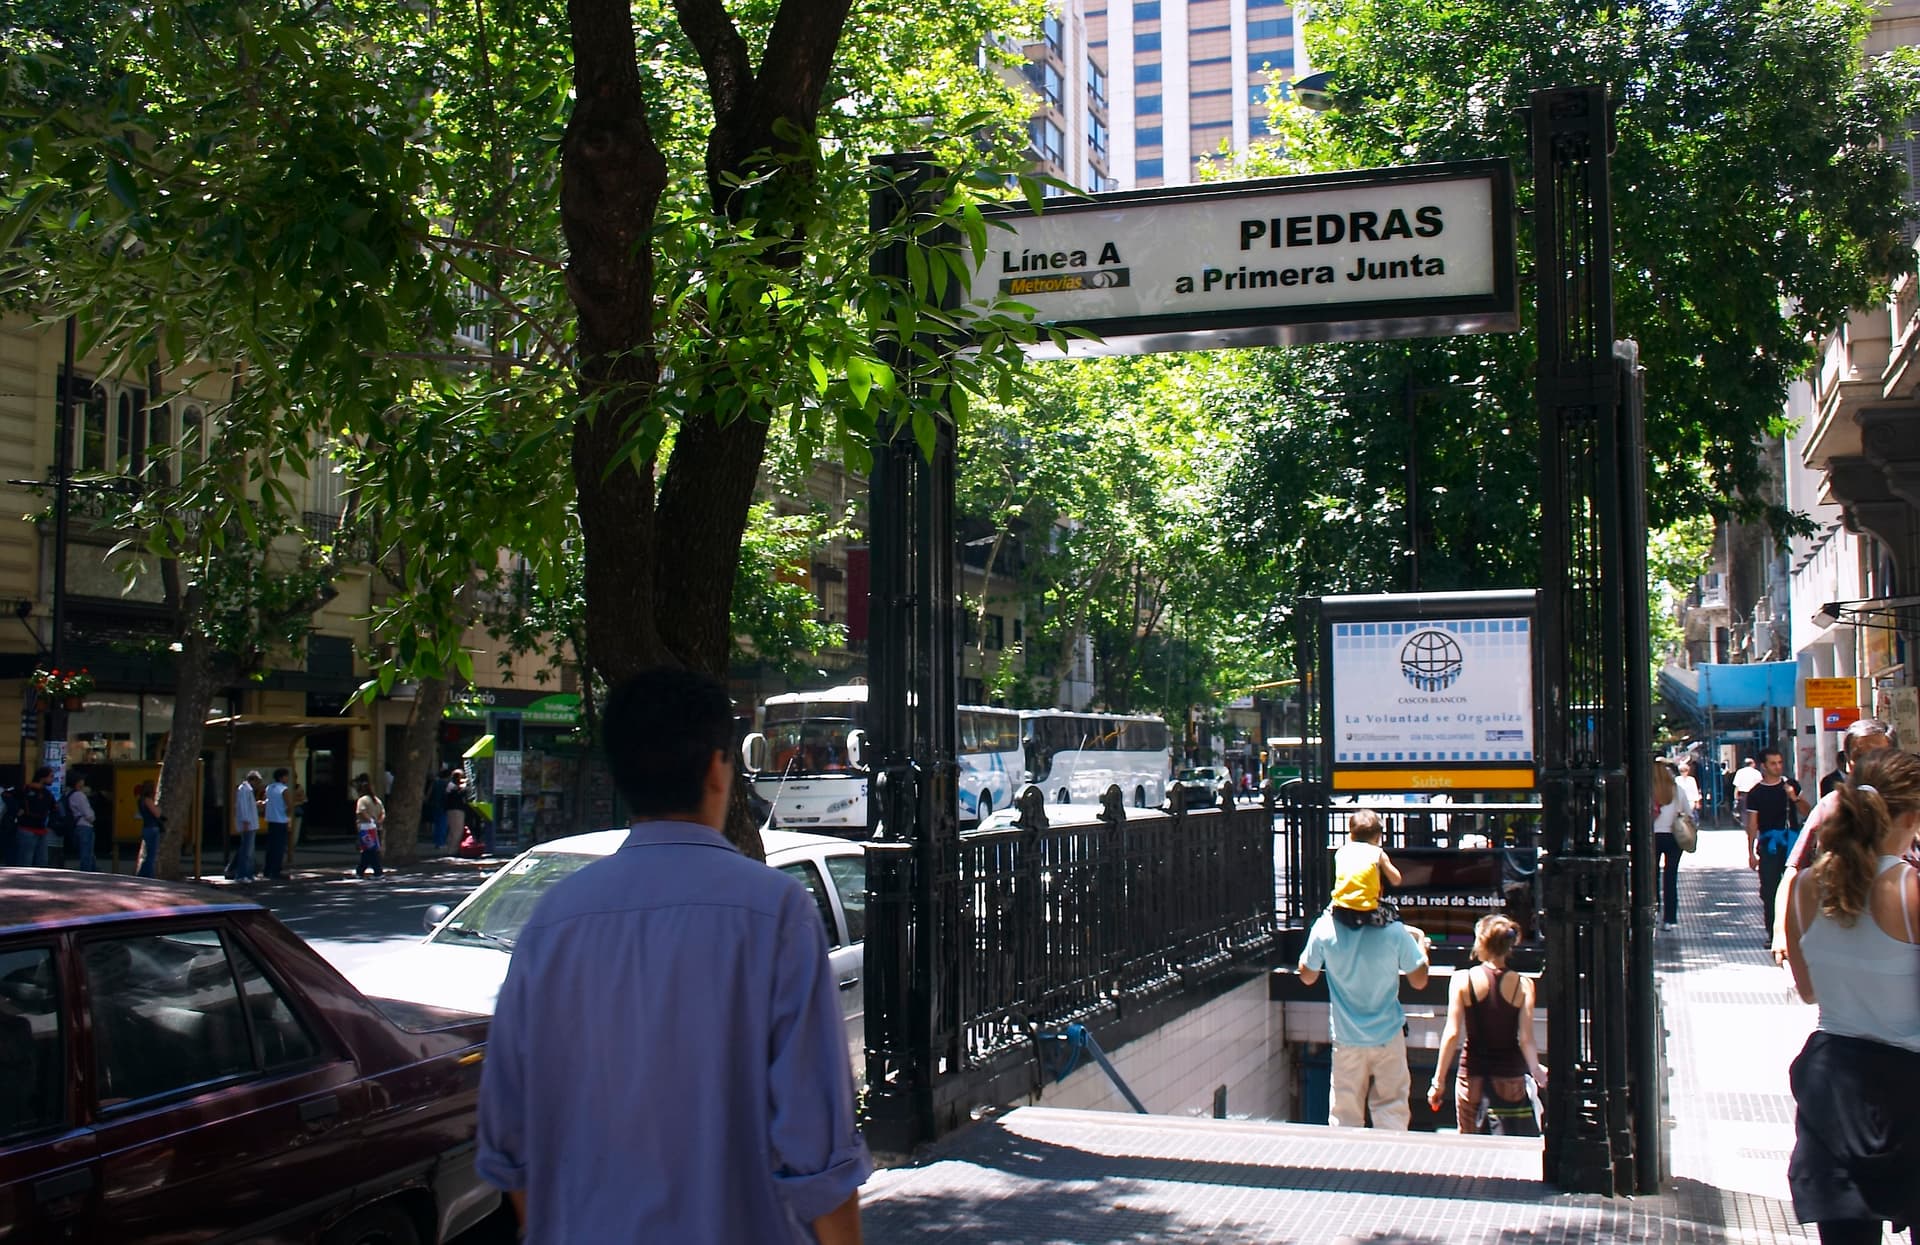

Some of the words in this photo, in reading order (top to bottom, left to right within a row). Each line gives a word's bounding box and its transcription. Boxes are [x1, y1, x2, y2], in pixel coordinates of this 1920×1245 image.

[1239, 205, 1444, 250] PIEDRAS
[1002, 248, 1088, 274] Línea
[1097, 242, 1121, 266] A
[1175, 276, 1194, 294] a
[1203, 265, 1335, 293] Primera
[1346, 253, 1445, 282] Junta
[1398, 697, 1429, 705] CASCOS
[1430, 696, 1467, 704] BLANCOS
[1345, 715, 1360, 724] La
[1365, 713, 1429, 723] Voluntad
[1456, 713, 1522, 725] Organiza
[1412, 775, 1453, 787] Subte
[1400, 895, 1415, 906] de
[1417, 895, 1427, 906] la
[1430, 895, 1448, 906] red
[1450, 895, 1465, 906] de
[1467, 895, 1507, 907] Subtes
